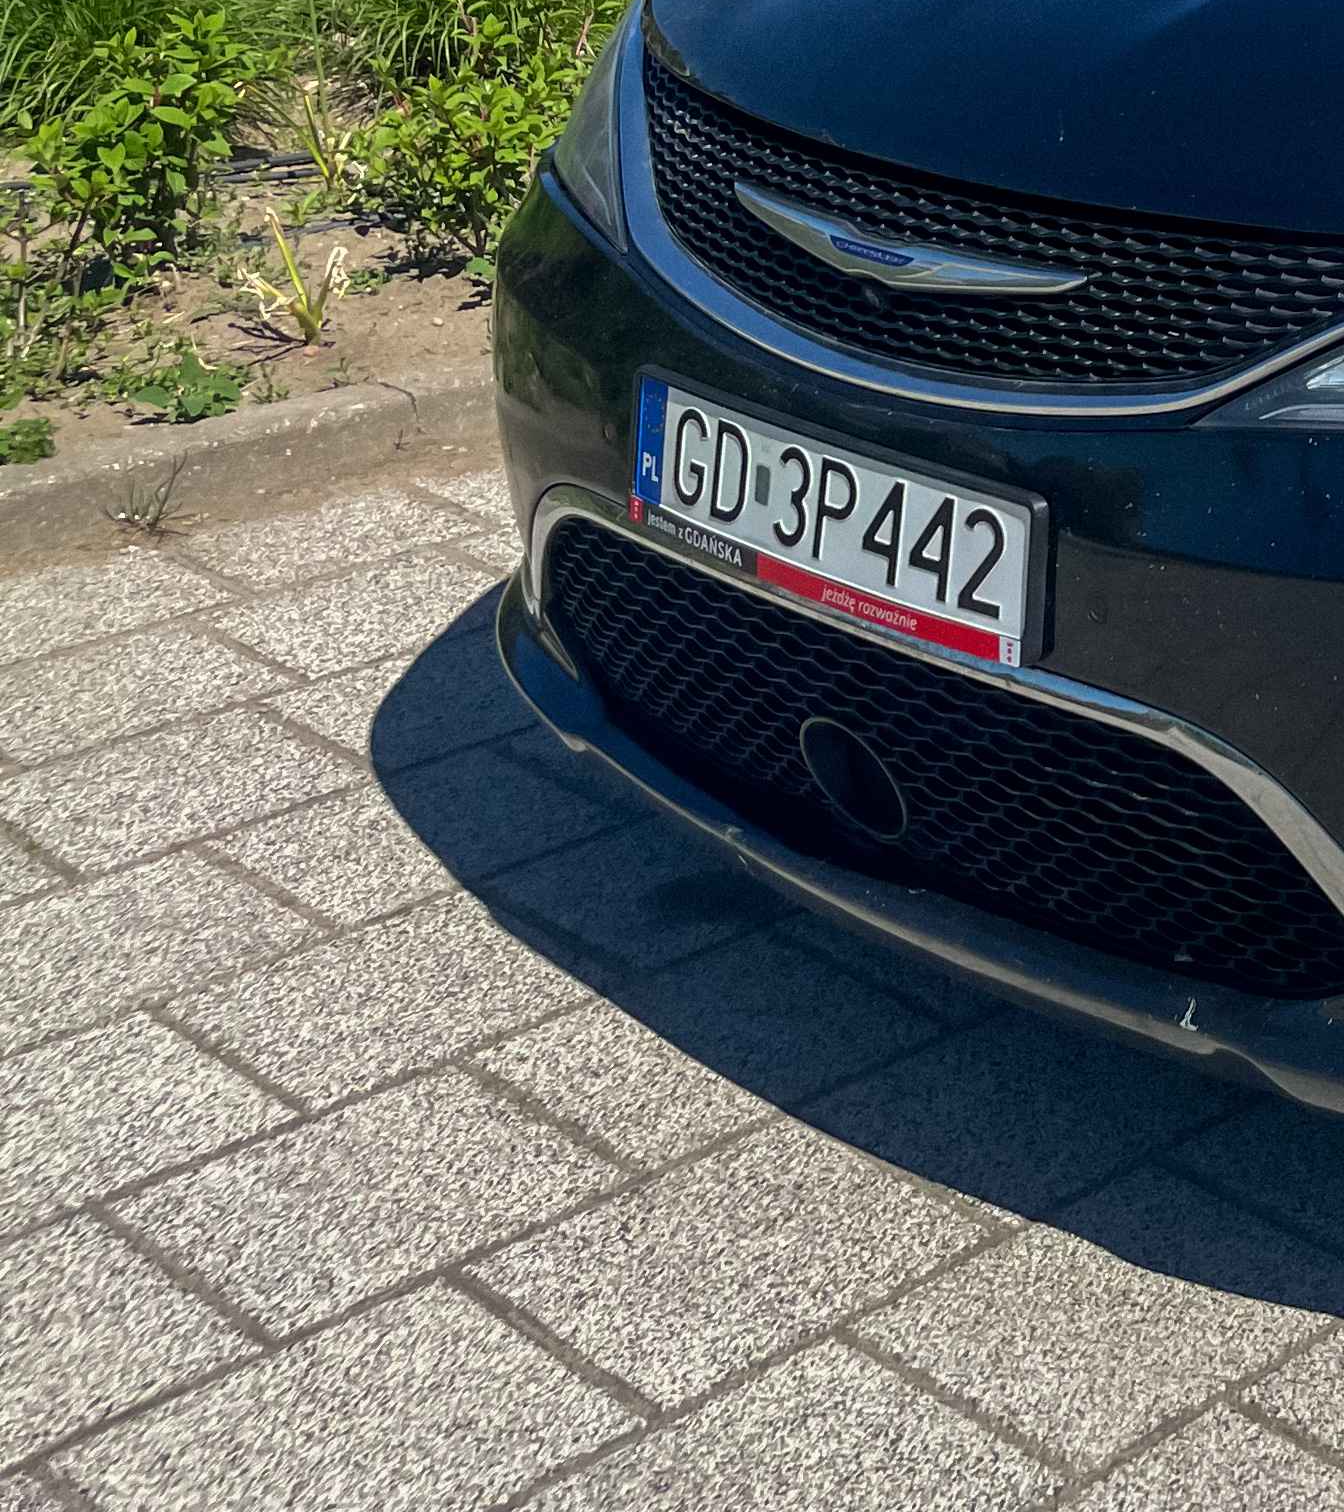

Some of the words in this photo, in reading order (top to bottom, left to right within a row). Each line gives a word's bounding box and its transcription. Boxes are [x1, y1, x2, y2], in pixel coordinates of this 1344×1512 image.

[642, 451, 659, 482] PL
[673, 407, 752, 523] GD
[772, 444, 1005, 621] 3P442
[684, 526, 743, 567] GDAŃSKA
